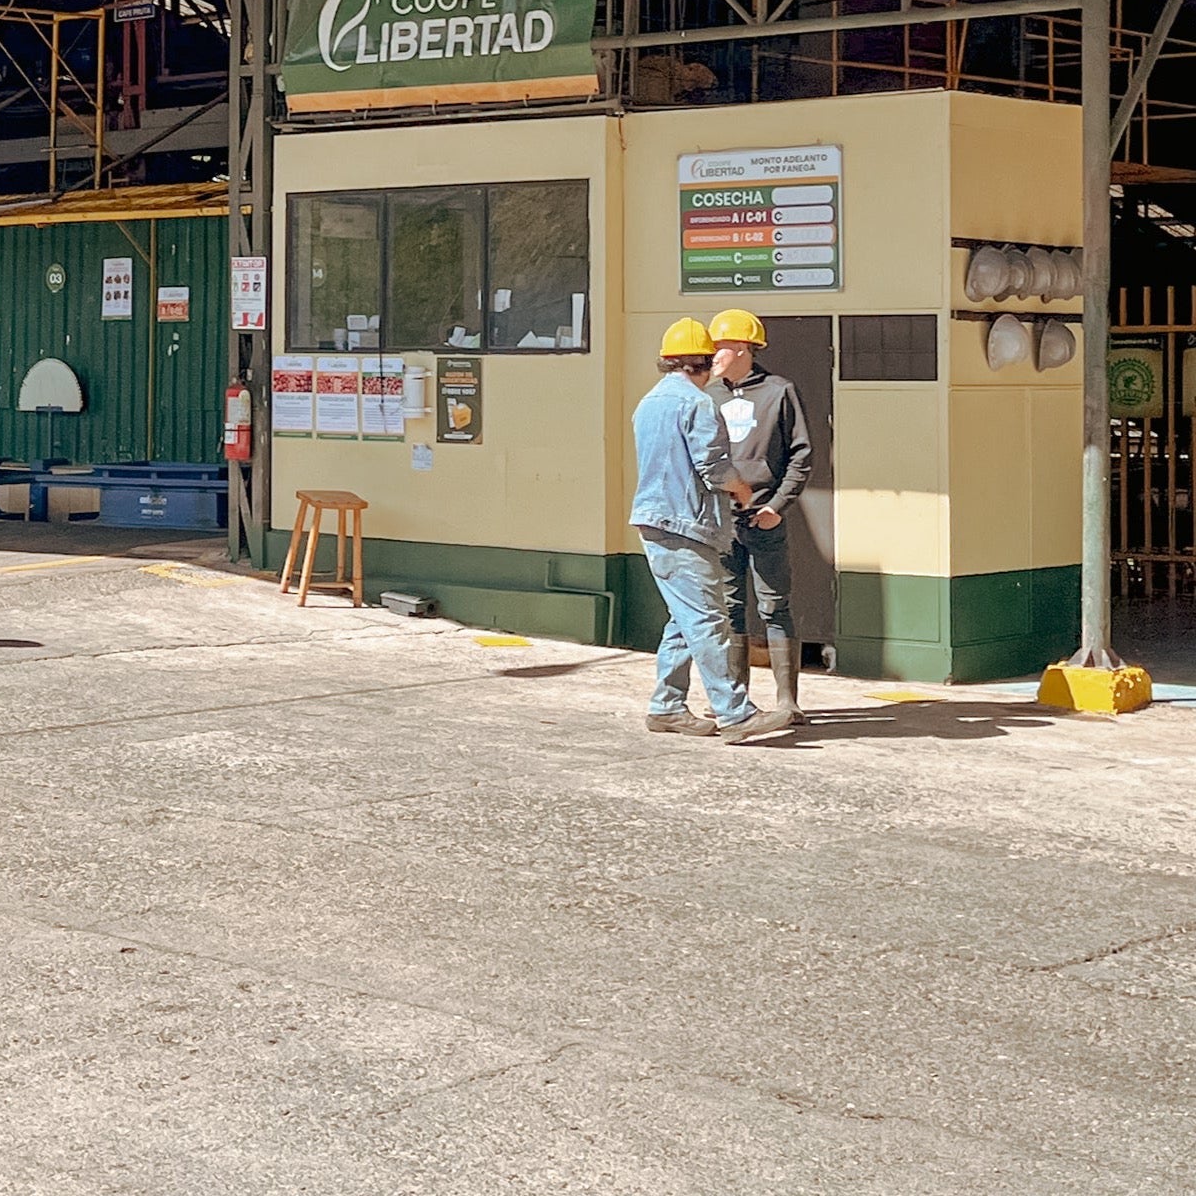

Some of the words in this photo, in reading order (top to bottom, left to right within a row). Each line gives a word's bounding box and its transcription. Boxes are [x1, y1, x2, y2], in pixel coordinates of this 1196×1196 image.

[355, 10, 553, 64] LIBERTAD
[751, 156, 782, 165] MONTO
[783, 154, 828, 163] ADELANTO
[700, 166, 745, 178] LIBERTAD
[763, 165, 780, 174] POR
[781, 163, 816, 173] FANEGA
[692, 191, 764, 208] COSECHA
[732, 212, 740, 224] A
[732, 233, 740, 243] B
[734, 252, 742, 264] C
[49, 273, 63, 284] 03
[734, 273, 743, 286] C
